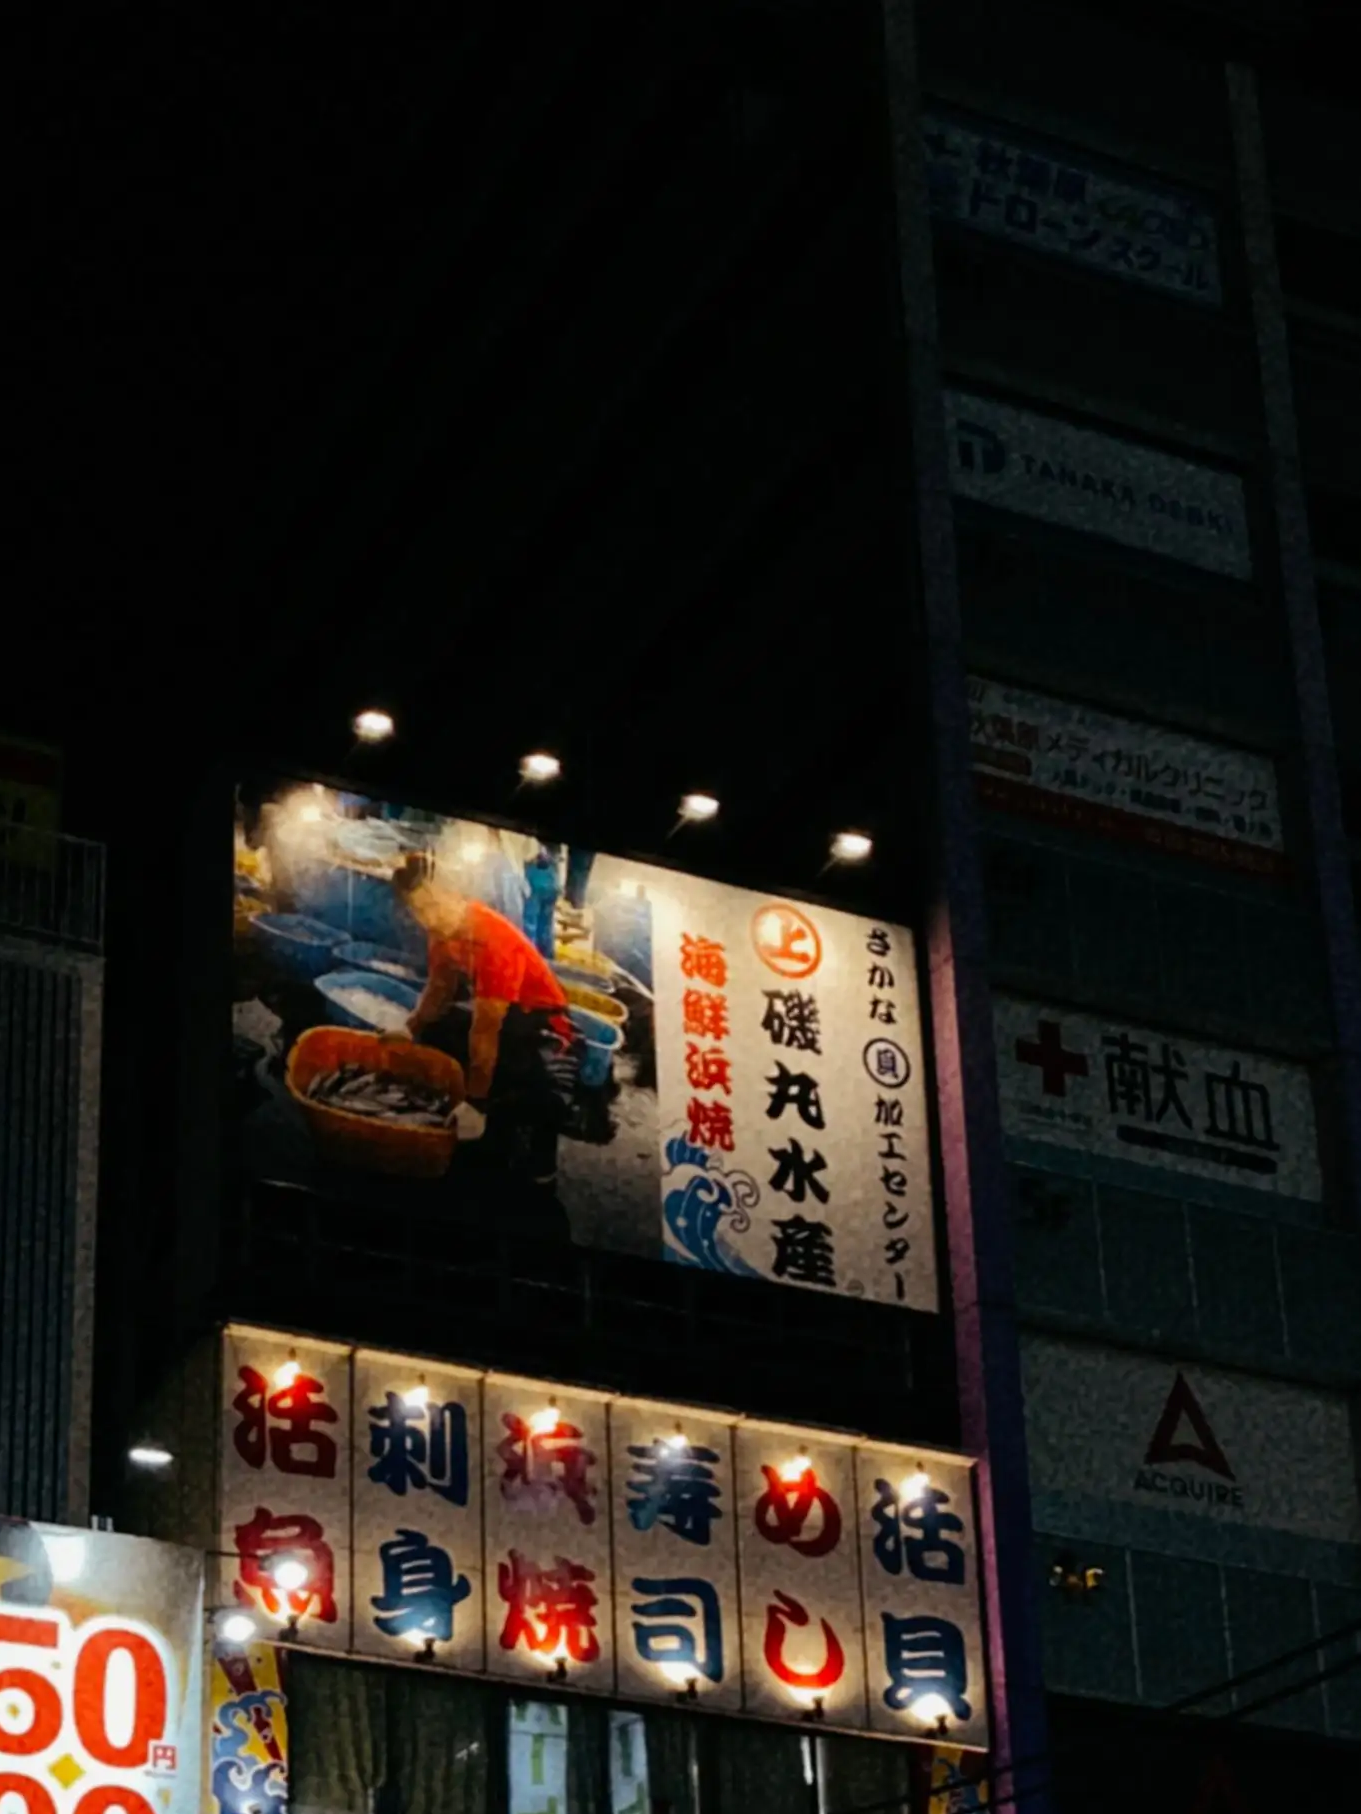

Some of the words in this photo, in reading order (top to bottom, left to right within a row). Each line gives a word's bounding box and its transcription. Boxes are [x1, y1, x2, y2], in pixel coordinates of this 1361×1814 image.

[680, 931, 735, 1153] 海鮮浜焼
[761, 987, 838, 1288] 磯丸水産
[1101, 1033, 1280, 1151] 献血
[232, 1364, 340, 1623] 活魚
[367, 1389, 472, 1642] 刺身
[497, 1409, 602, 1664] 浜焼
[624, 1437, 725, 1685] 寿司
[754, 1459, 846, 1689] めし
[872, 1476, 973, 1722] 活貝
[1133, 1470, 1244, 1507] ACQUIRE
